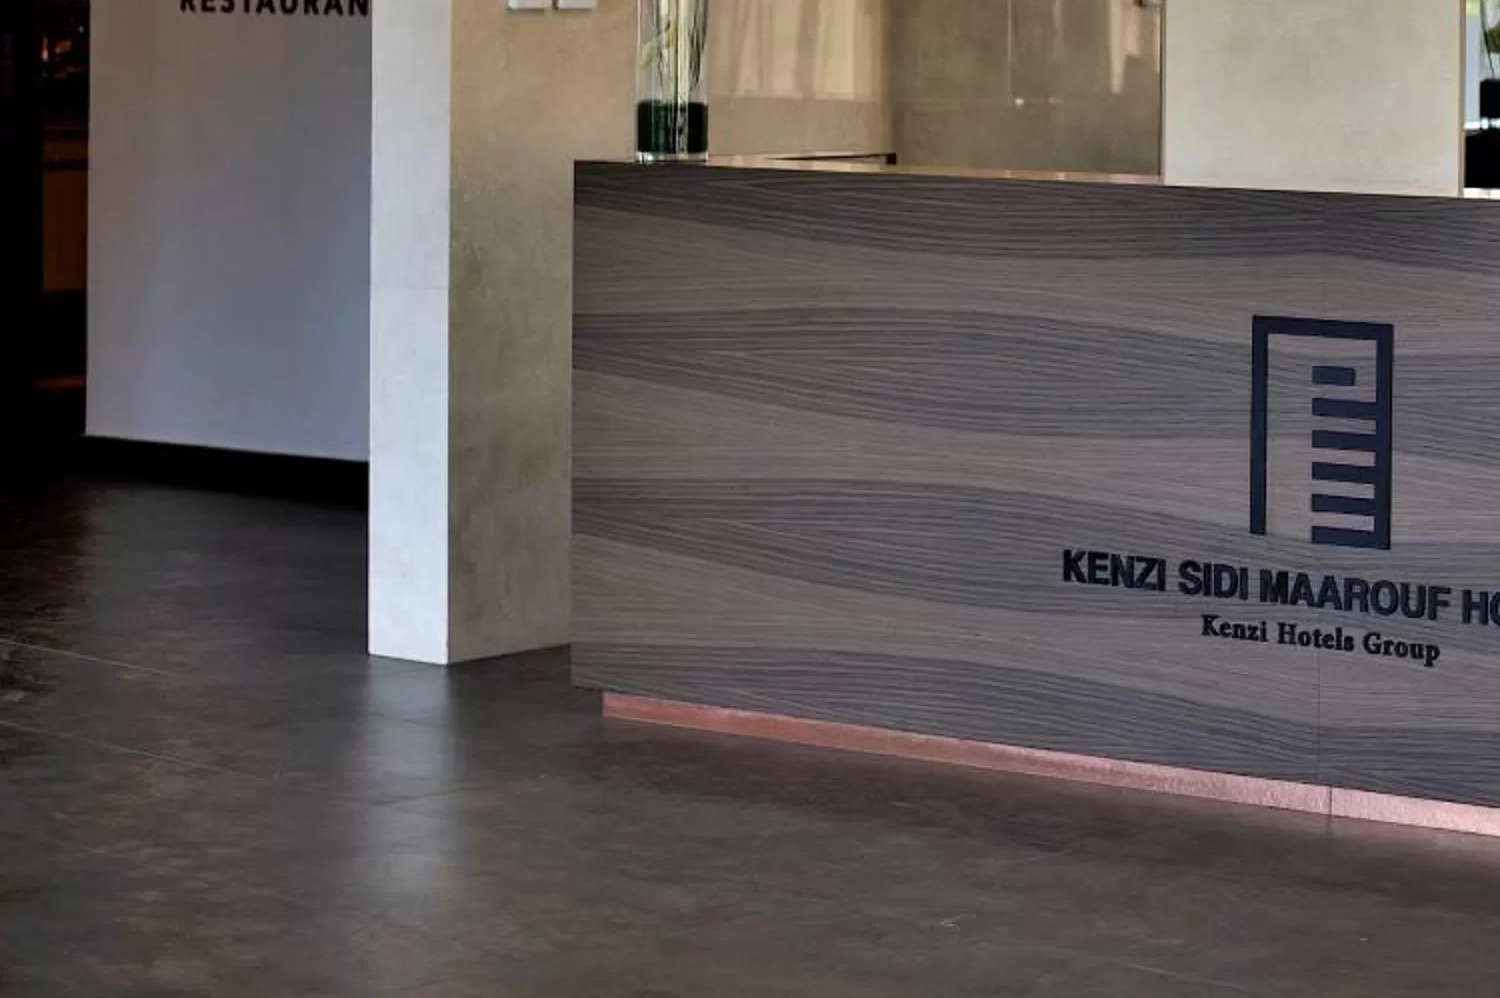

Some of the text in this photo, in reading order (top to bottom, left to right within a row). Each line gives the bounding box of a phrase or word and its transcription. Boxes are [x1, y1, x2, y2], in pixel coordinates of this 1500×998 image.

[1062, 549, 1167, 591] KENZI
[1178, 560, 1248, 600] SIDI
[1259, 570, 1452, 619] MAAROUF
[1201, 614, 1441, 666] Kenzi Hotels Group
